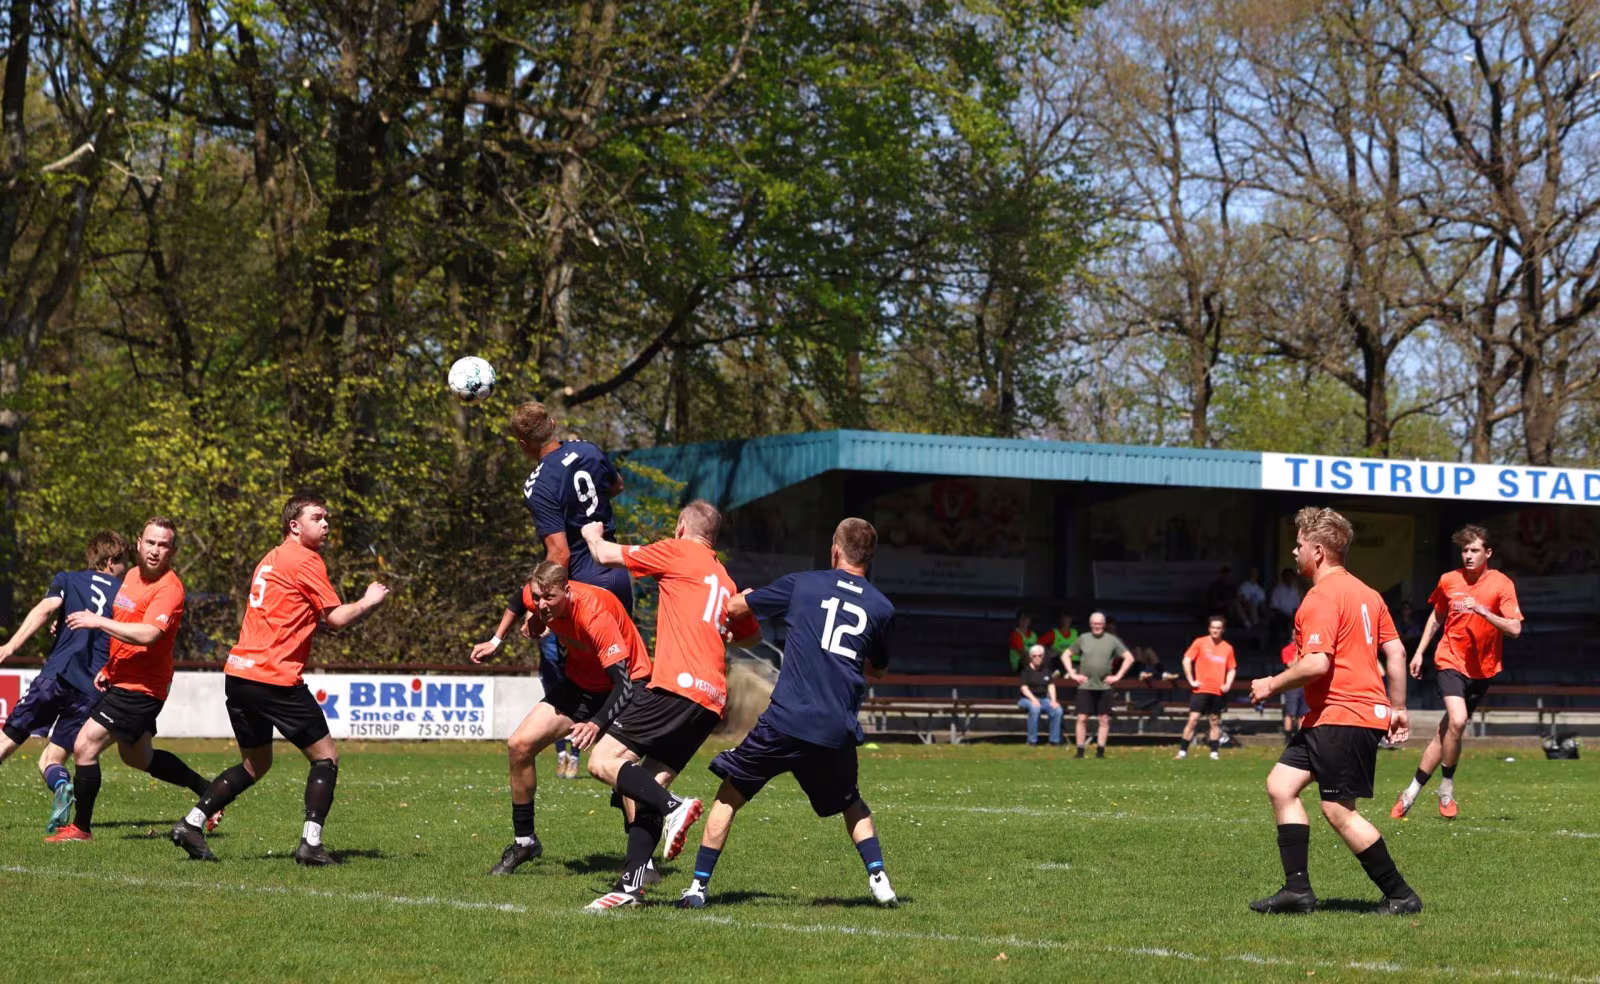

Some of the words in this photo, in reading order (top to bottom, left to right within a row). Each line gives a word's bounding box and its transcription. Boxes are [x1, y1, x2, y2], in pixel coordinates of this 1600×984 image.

[573, 470, 599, 517] 9
[1284, 457, 1476, 495] TISTRUP
[1498, 469, 1600, 501] STAD
[249, 565, 273, 608] 5
[820, 596, 868, 660] 12
[349, 723, 400, 736] TISTRUP
[418, 723, 432, 736] 75
[434, 723, 450, 736] 29
[453, 723, 466, 736] 91
[469, 723, 485, 737] 96
[350, 709, 416, 722] Smede
[422, 709, 435, 722] &
[441, 710, 480, 722] VVS
